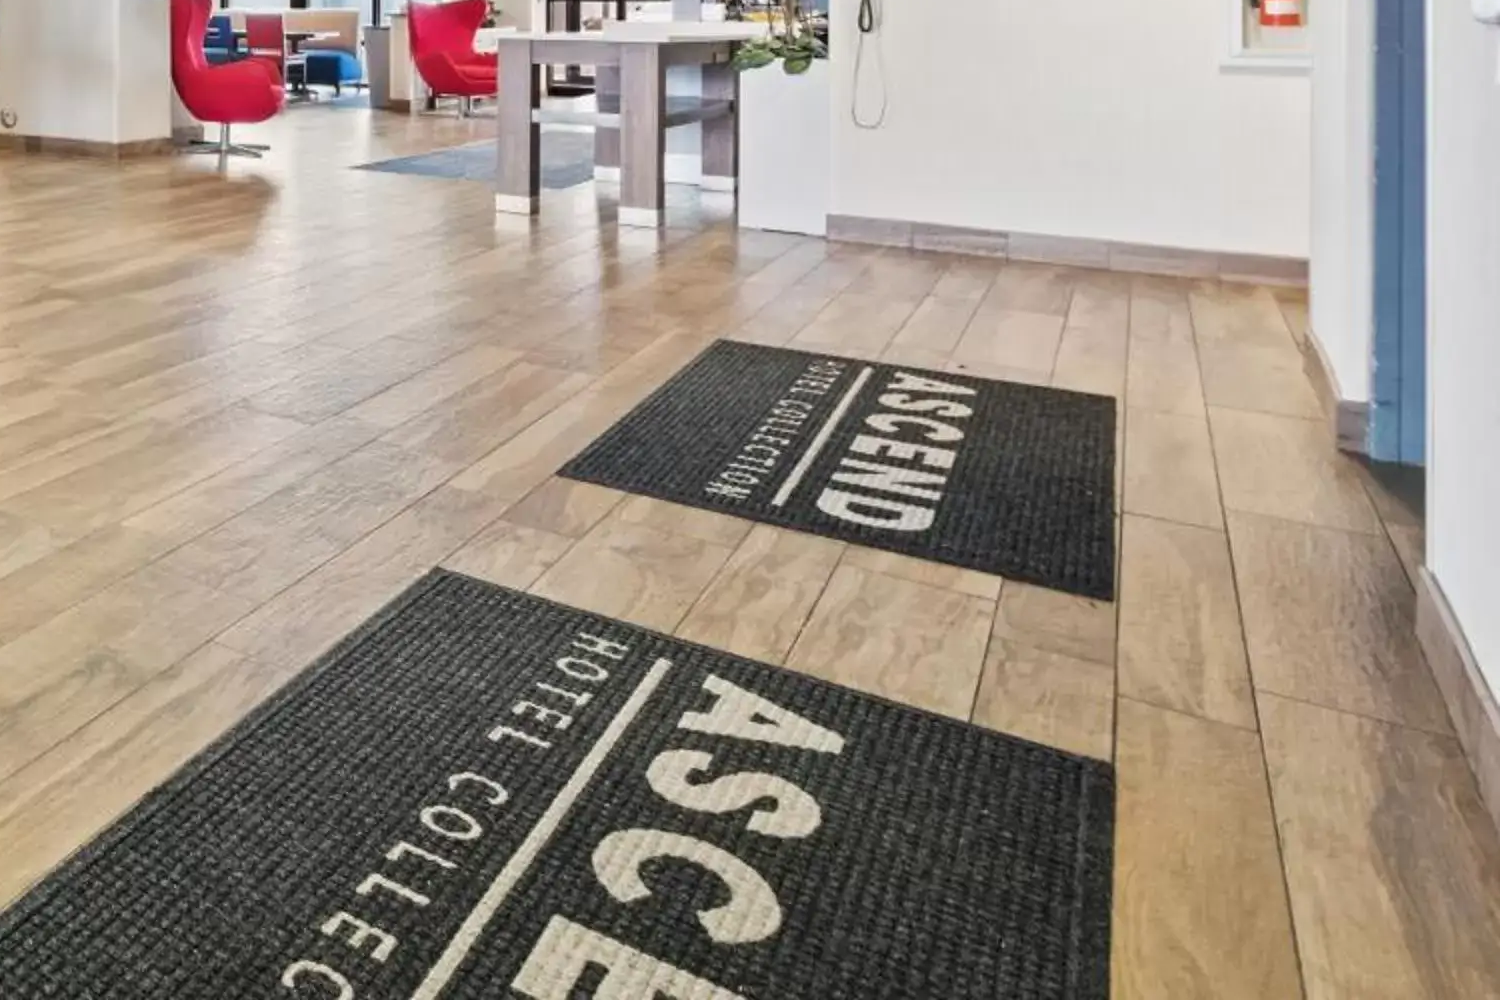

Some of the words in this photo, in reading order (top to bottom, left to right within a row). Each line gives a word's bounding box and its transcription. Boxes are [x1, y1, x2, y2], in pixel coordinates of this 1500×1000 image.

[704, 398, 813, 500] COLLECTION
[816, 371, 977, 532] ASCEND
[487, 631, 630, 750] HOTEL
